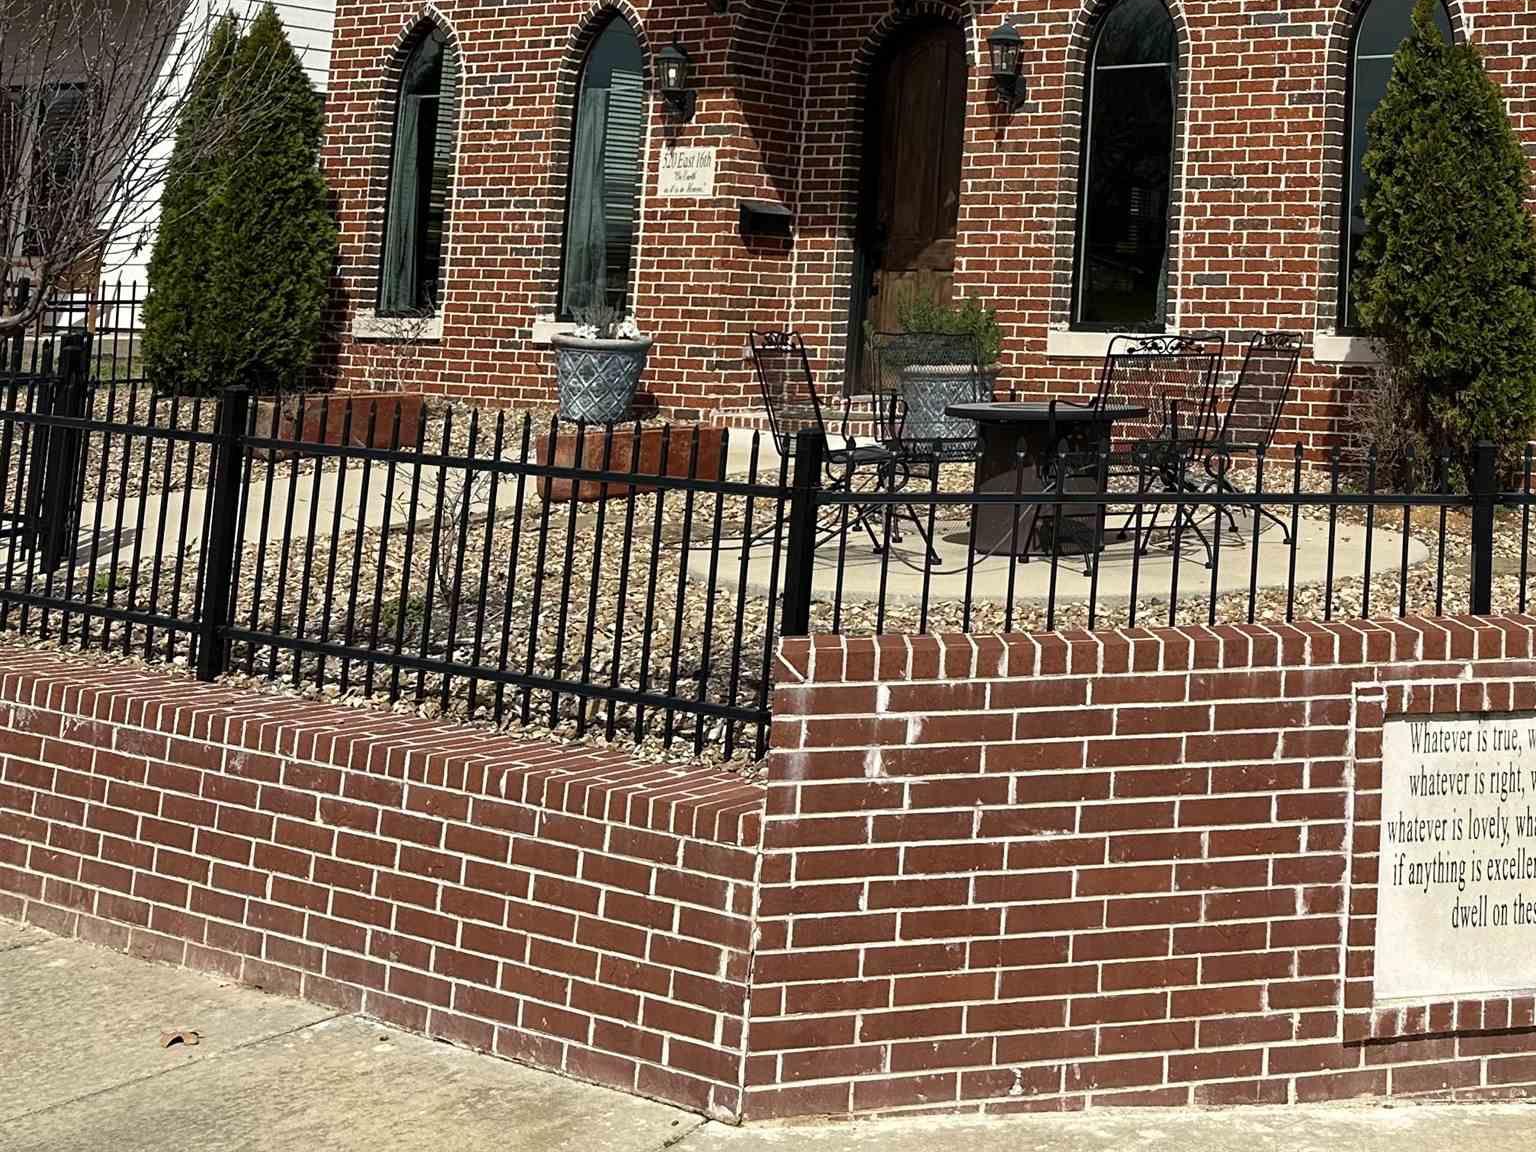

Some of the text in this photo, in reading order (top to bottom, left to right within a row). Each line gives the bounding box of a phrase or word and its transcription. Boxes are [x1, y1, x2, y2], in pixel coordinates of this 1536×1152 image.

[677, 151, 695, 169] East
[1410, 722, 1472, 754] Whatever
[1477, 720, 1488, 752] is
[1493, 725, 1522, 757] true,
[1409, 764, 1470, 797] whatever
[1474, 761, 1485, 794] is
[1489, 761, 1525, 802] right,
[1387, 810, 1448, 844] whatever
[1452, 807, 1463, 841] is
[1468, 806, 1510, 848] lovely,
[1393, 852, 1406, 886] if
[1408, 851, 1466, 894] anything
[1471, 849, 1482, 882] is
[1451, 895, 1488, 929] dwell
[1492, 901, 1508, 926] on
